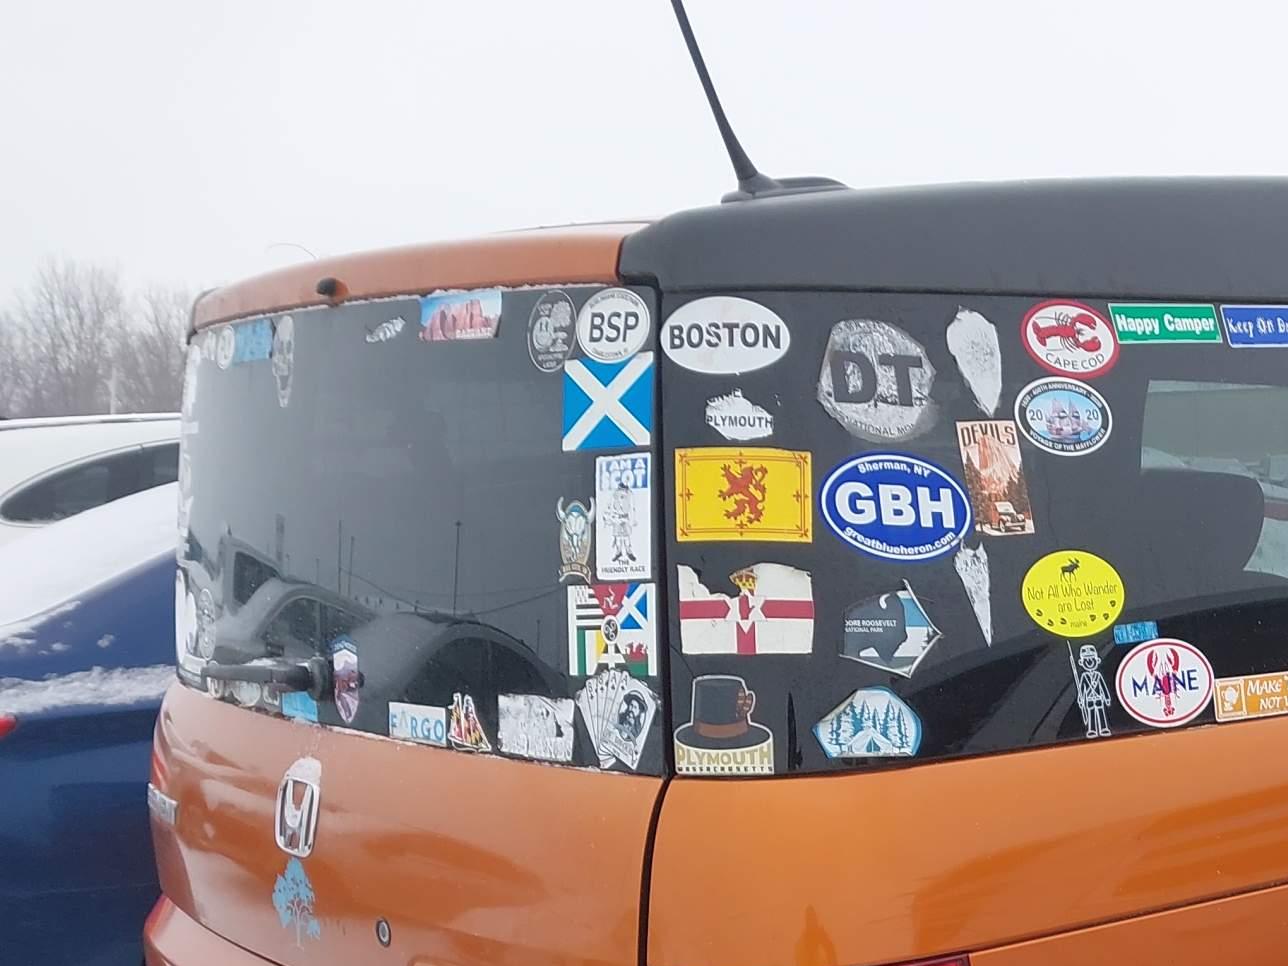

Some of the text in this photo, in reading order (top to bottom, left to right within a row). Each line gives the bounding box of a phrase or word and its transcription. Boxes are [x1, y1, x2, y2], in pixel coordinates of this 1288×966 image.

[589, 311, 639, 342] BSP
[1115, 313, 1215, 335] Happy Camper
[1227, 317, 1253, 337] Keep
[1256, 317, 1274, 334] On
[669, 323, 781, 349] BOSTON
[1045, 353, 1105, 370] CAPE COD
[830, 351, 922, 406] DT
[706, 415, 773, 428] PLYMOUTH
[1029, 409, 1099, 421] 20 20
[961, 422, 1016, 447] DEVILS
[1054, 442, 1063, 450] OF
[1075, 427, 1106, 450] MAYFLOWER
[609, 459, 632, 472] AM
[635, 458, 646, 470] A
[857, 461, 931, 478] Sherman, NY
[835, 481, 955, 528] GBH
[843, 526, 956, 555] greatblueheron.com
[1027, 581, 1118, 601] Not All Who Wander
[1057, 599, 1095, 613] are Lost
[862, 619, 897, 627] ROOSEVELT
[1132, 669, 1199, 697] MAINE
[1247, 679, 1282, 696] MAKE
[1260, 696, 1282, 710] NOT
[677, 744, 771, 765] PLYMOUTH
